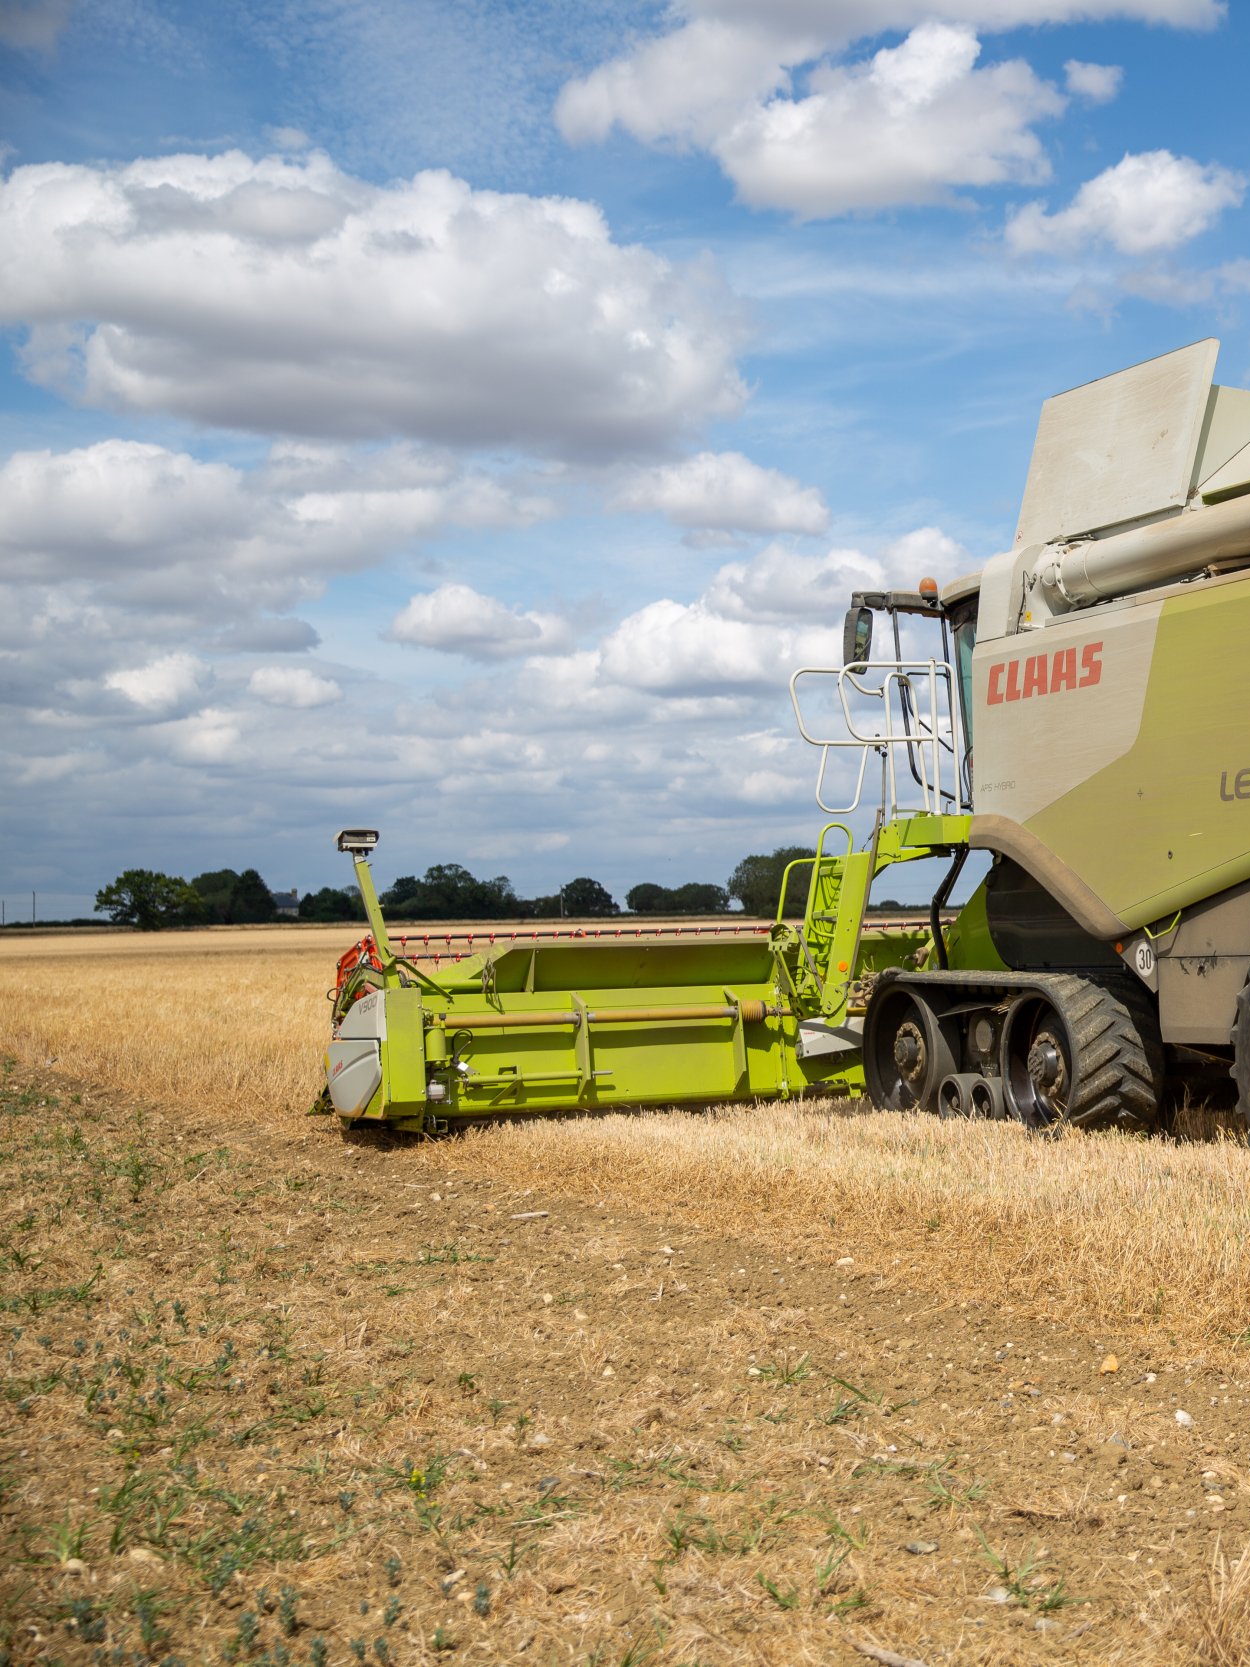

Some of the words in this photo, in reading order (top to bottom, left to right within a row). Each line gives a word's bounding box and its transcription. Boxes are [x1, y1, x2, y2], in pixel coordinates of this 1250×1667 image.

[986, 641, 1104, 706] CLAAS
[1138, 948, 1152, 970] 30
[358, 995, 378, 1016] V900
